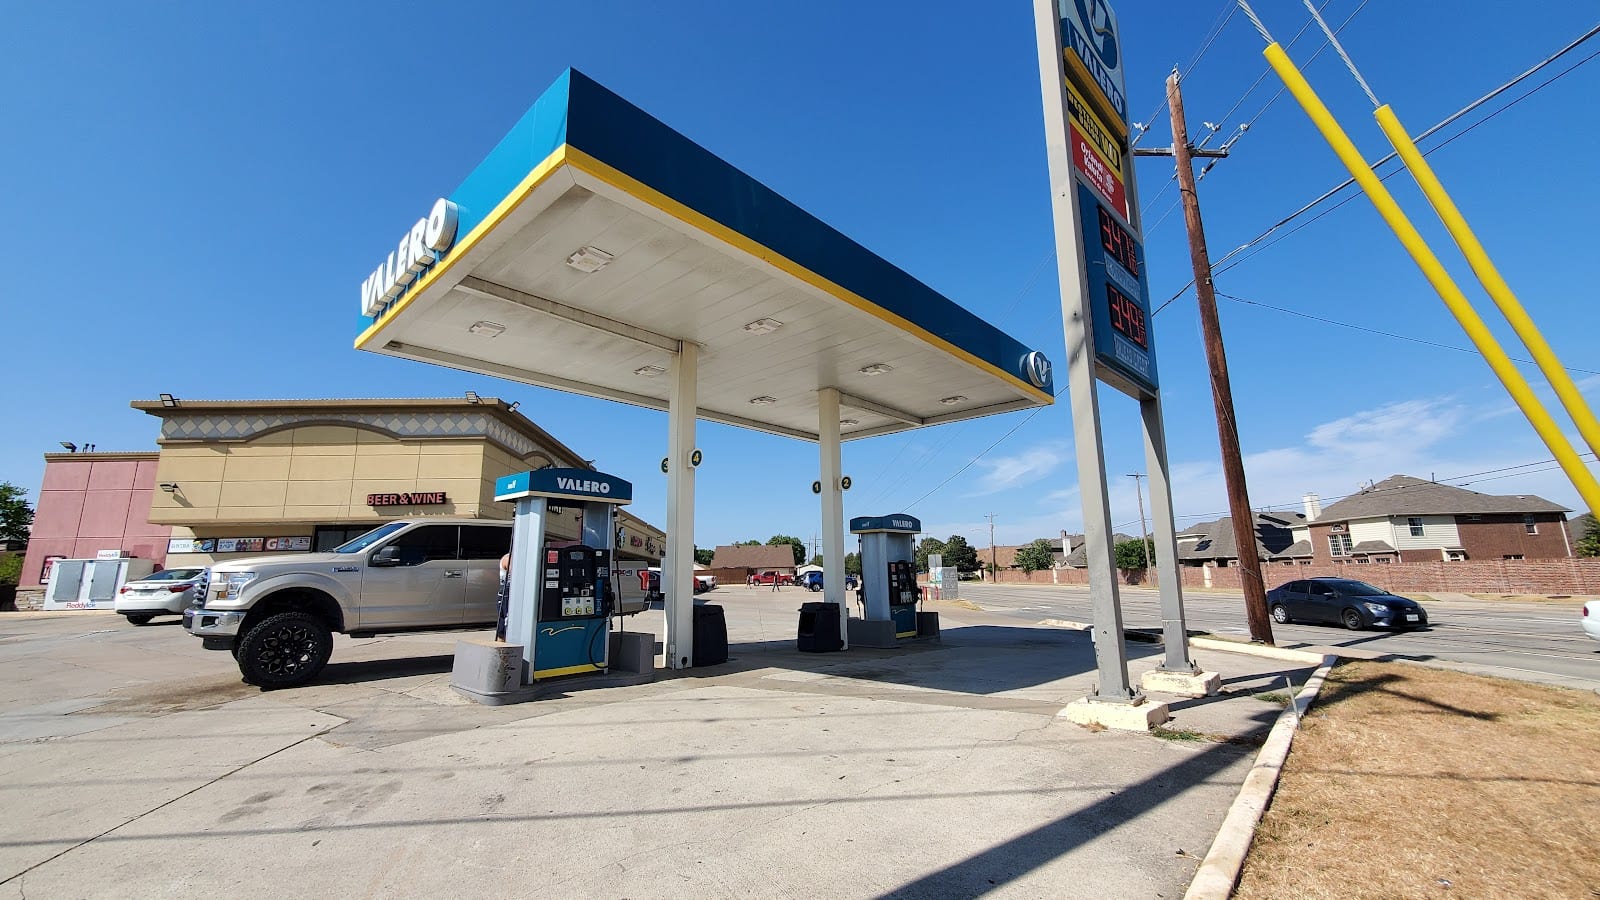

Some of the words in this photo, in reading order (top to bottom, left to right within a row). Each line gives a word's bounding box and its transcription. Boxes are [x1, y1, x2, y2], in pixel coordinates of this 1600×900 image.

[1074, 30, 1122, 114] VALERO
[1068, 90, 1099, 136] WESTERN
[1084, 155, 1103, 183] Valuta
[361, 197, 447, 316] VALERO
[367, 494, 398, 505] BEER
[399, 493, 409, 504] &
[411, 492, 444, 504] WINE
[557, 477, 610, 494] VALERO
[892, 519, 913, 528] VALERO
